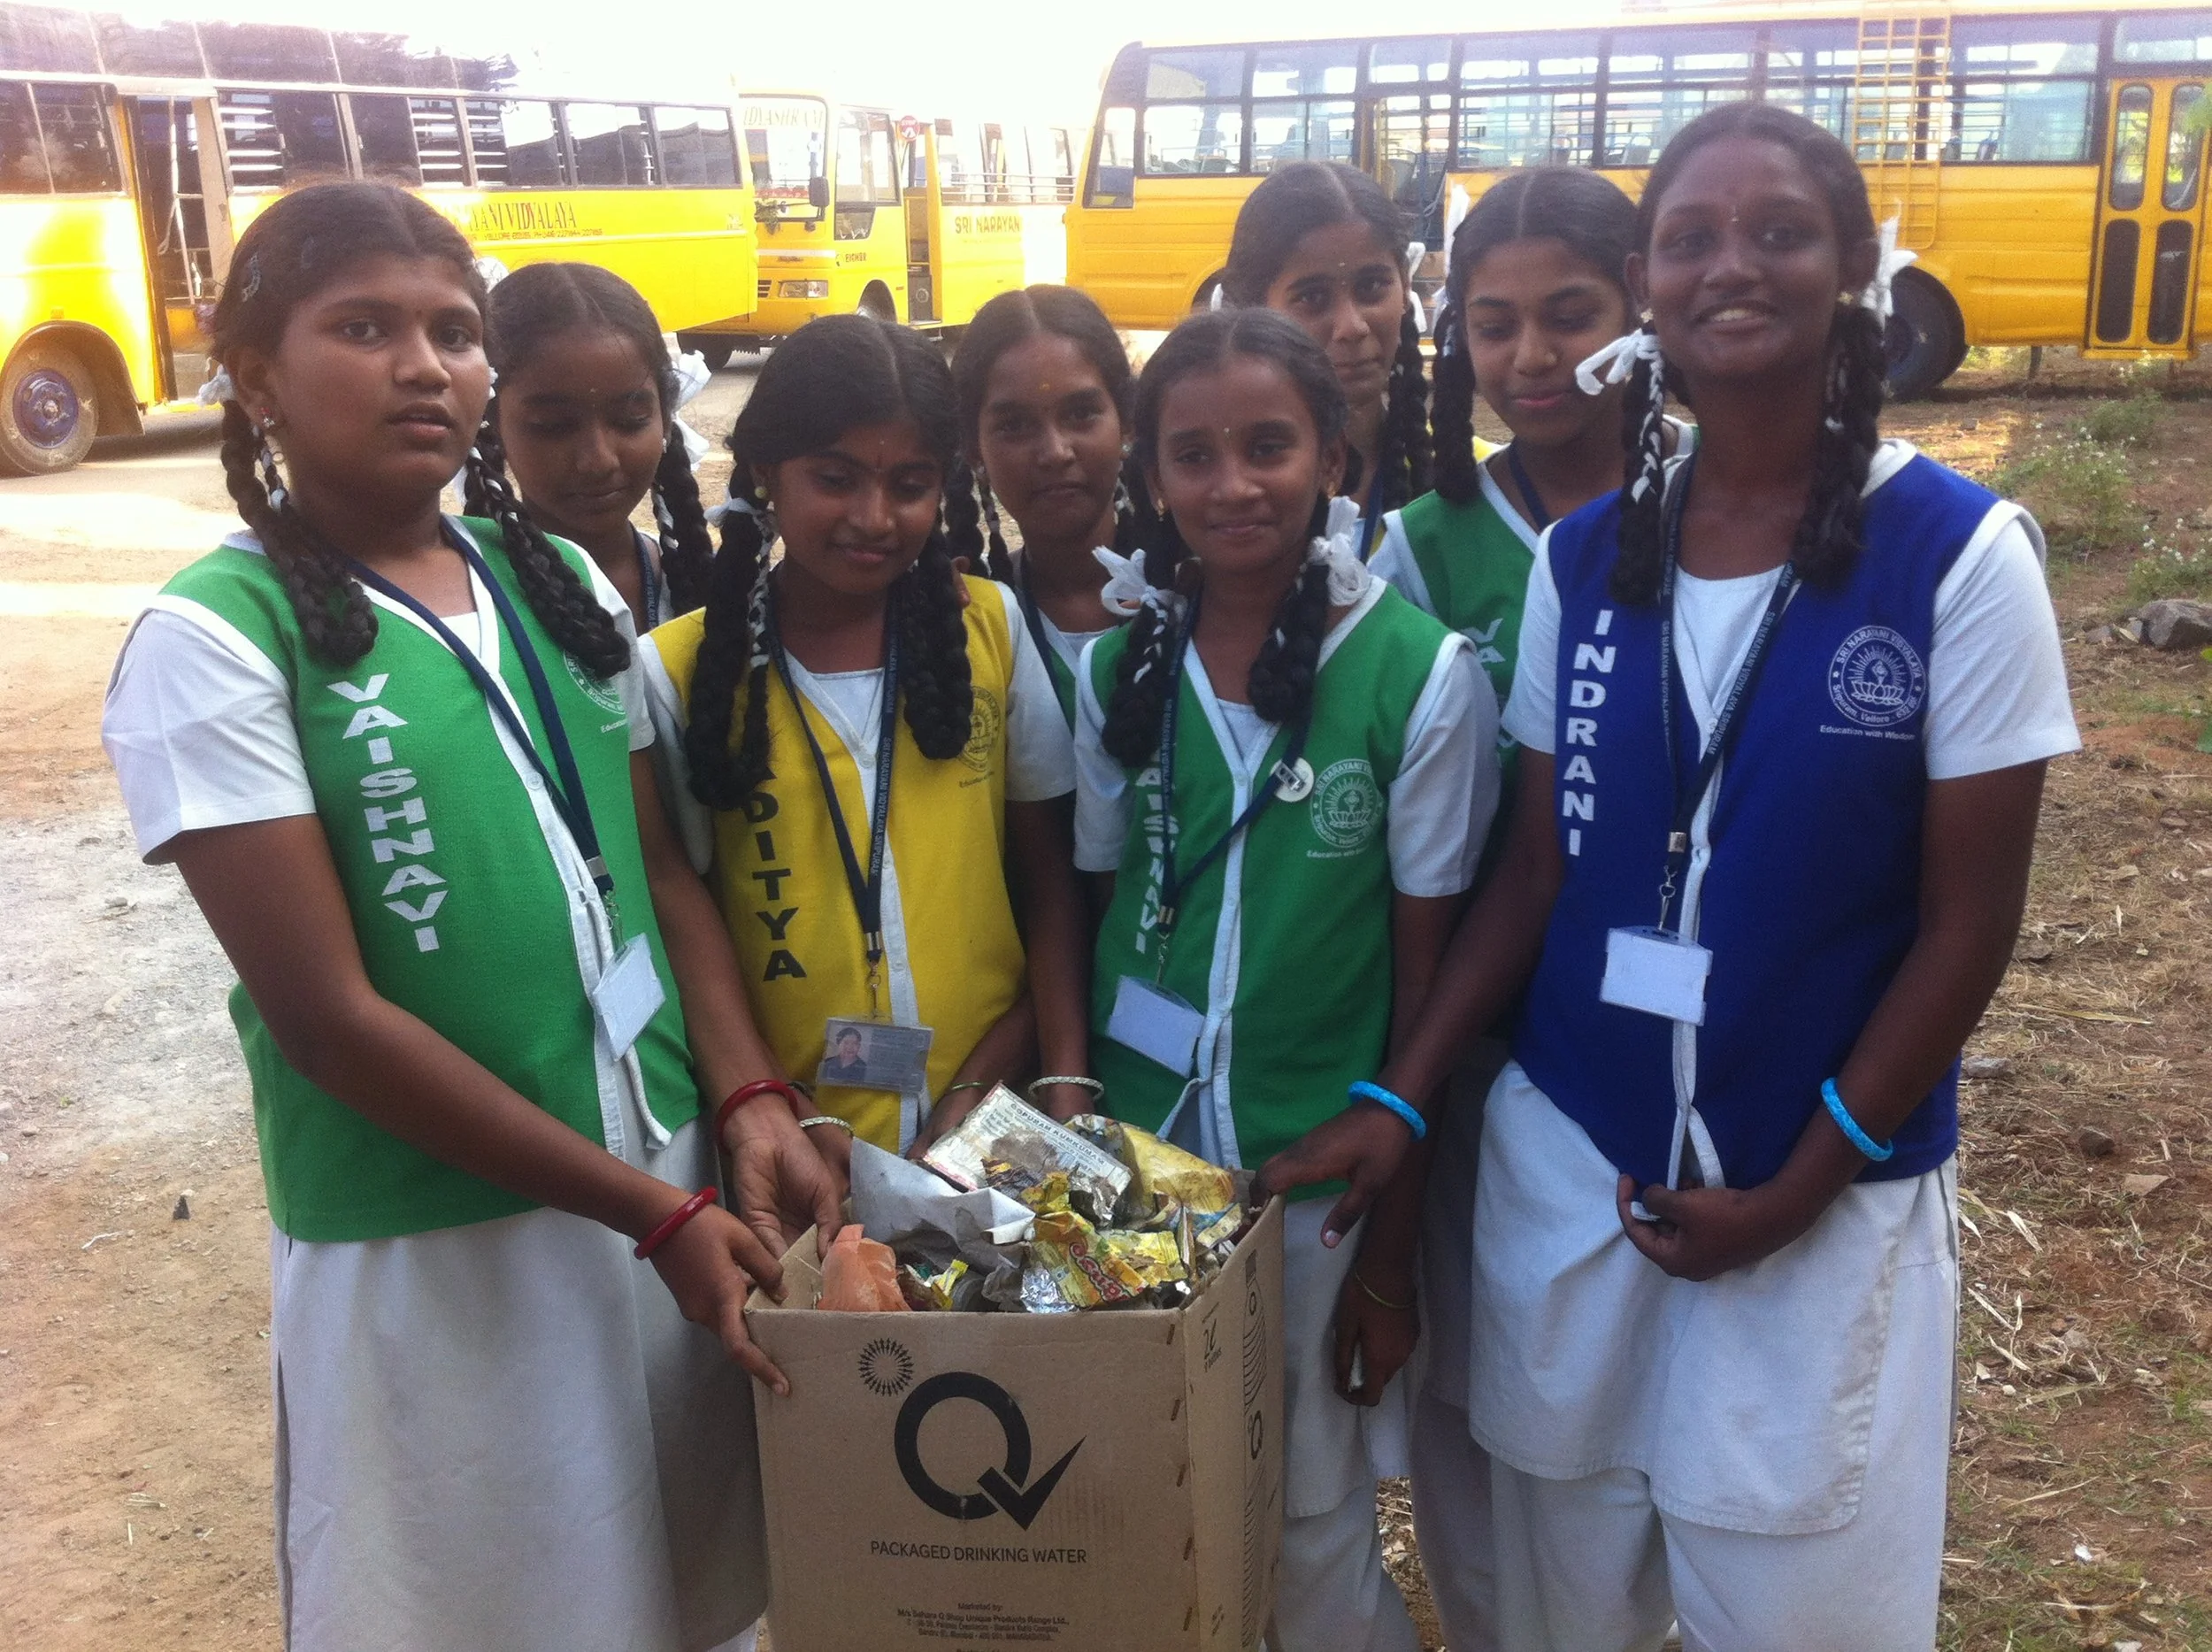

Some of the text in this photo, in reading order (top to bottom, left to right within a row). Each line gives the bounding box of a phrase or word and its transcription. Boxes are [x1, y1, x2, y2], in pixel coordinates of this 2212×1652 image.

[504, 201, 577, 230] VIDYALAYA
[955, 216, 972, 234] SRI
[1562, 609, 1617, 857] INDRANI
[1820, 725, 1863, 736] Education
[326, 672, 449, 953] VAISHNAVI
[744, 768, 807, 982] DITYA
[871, 1541, 1087, 1564] PACKAGED DRINKING WATER
